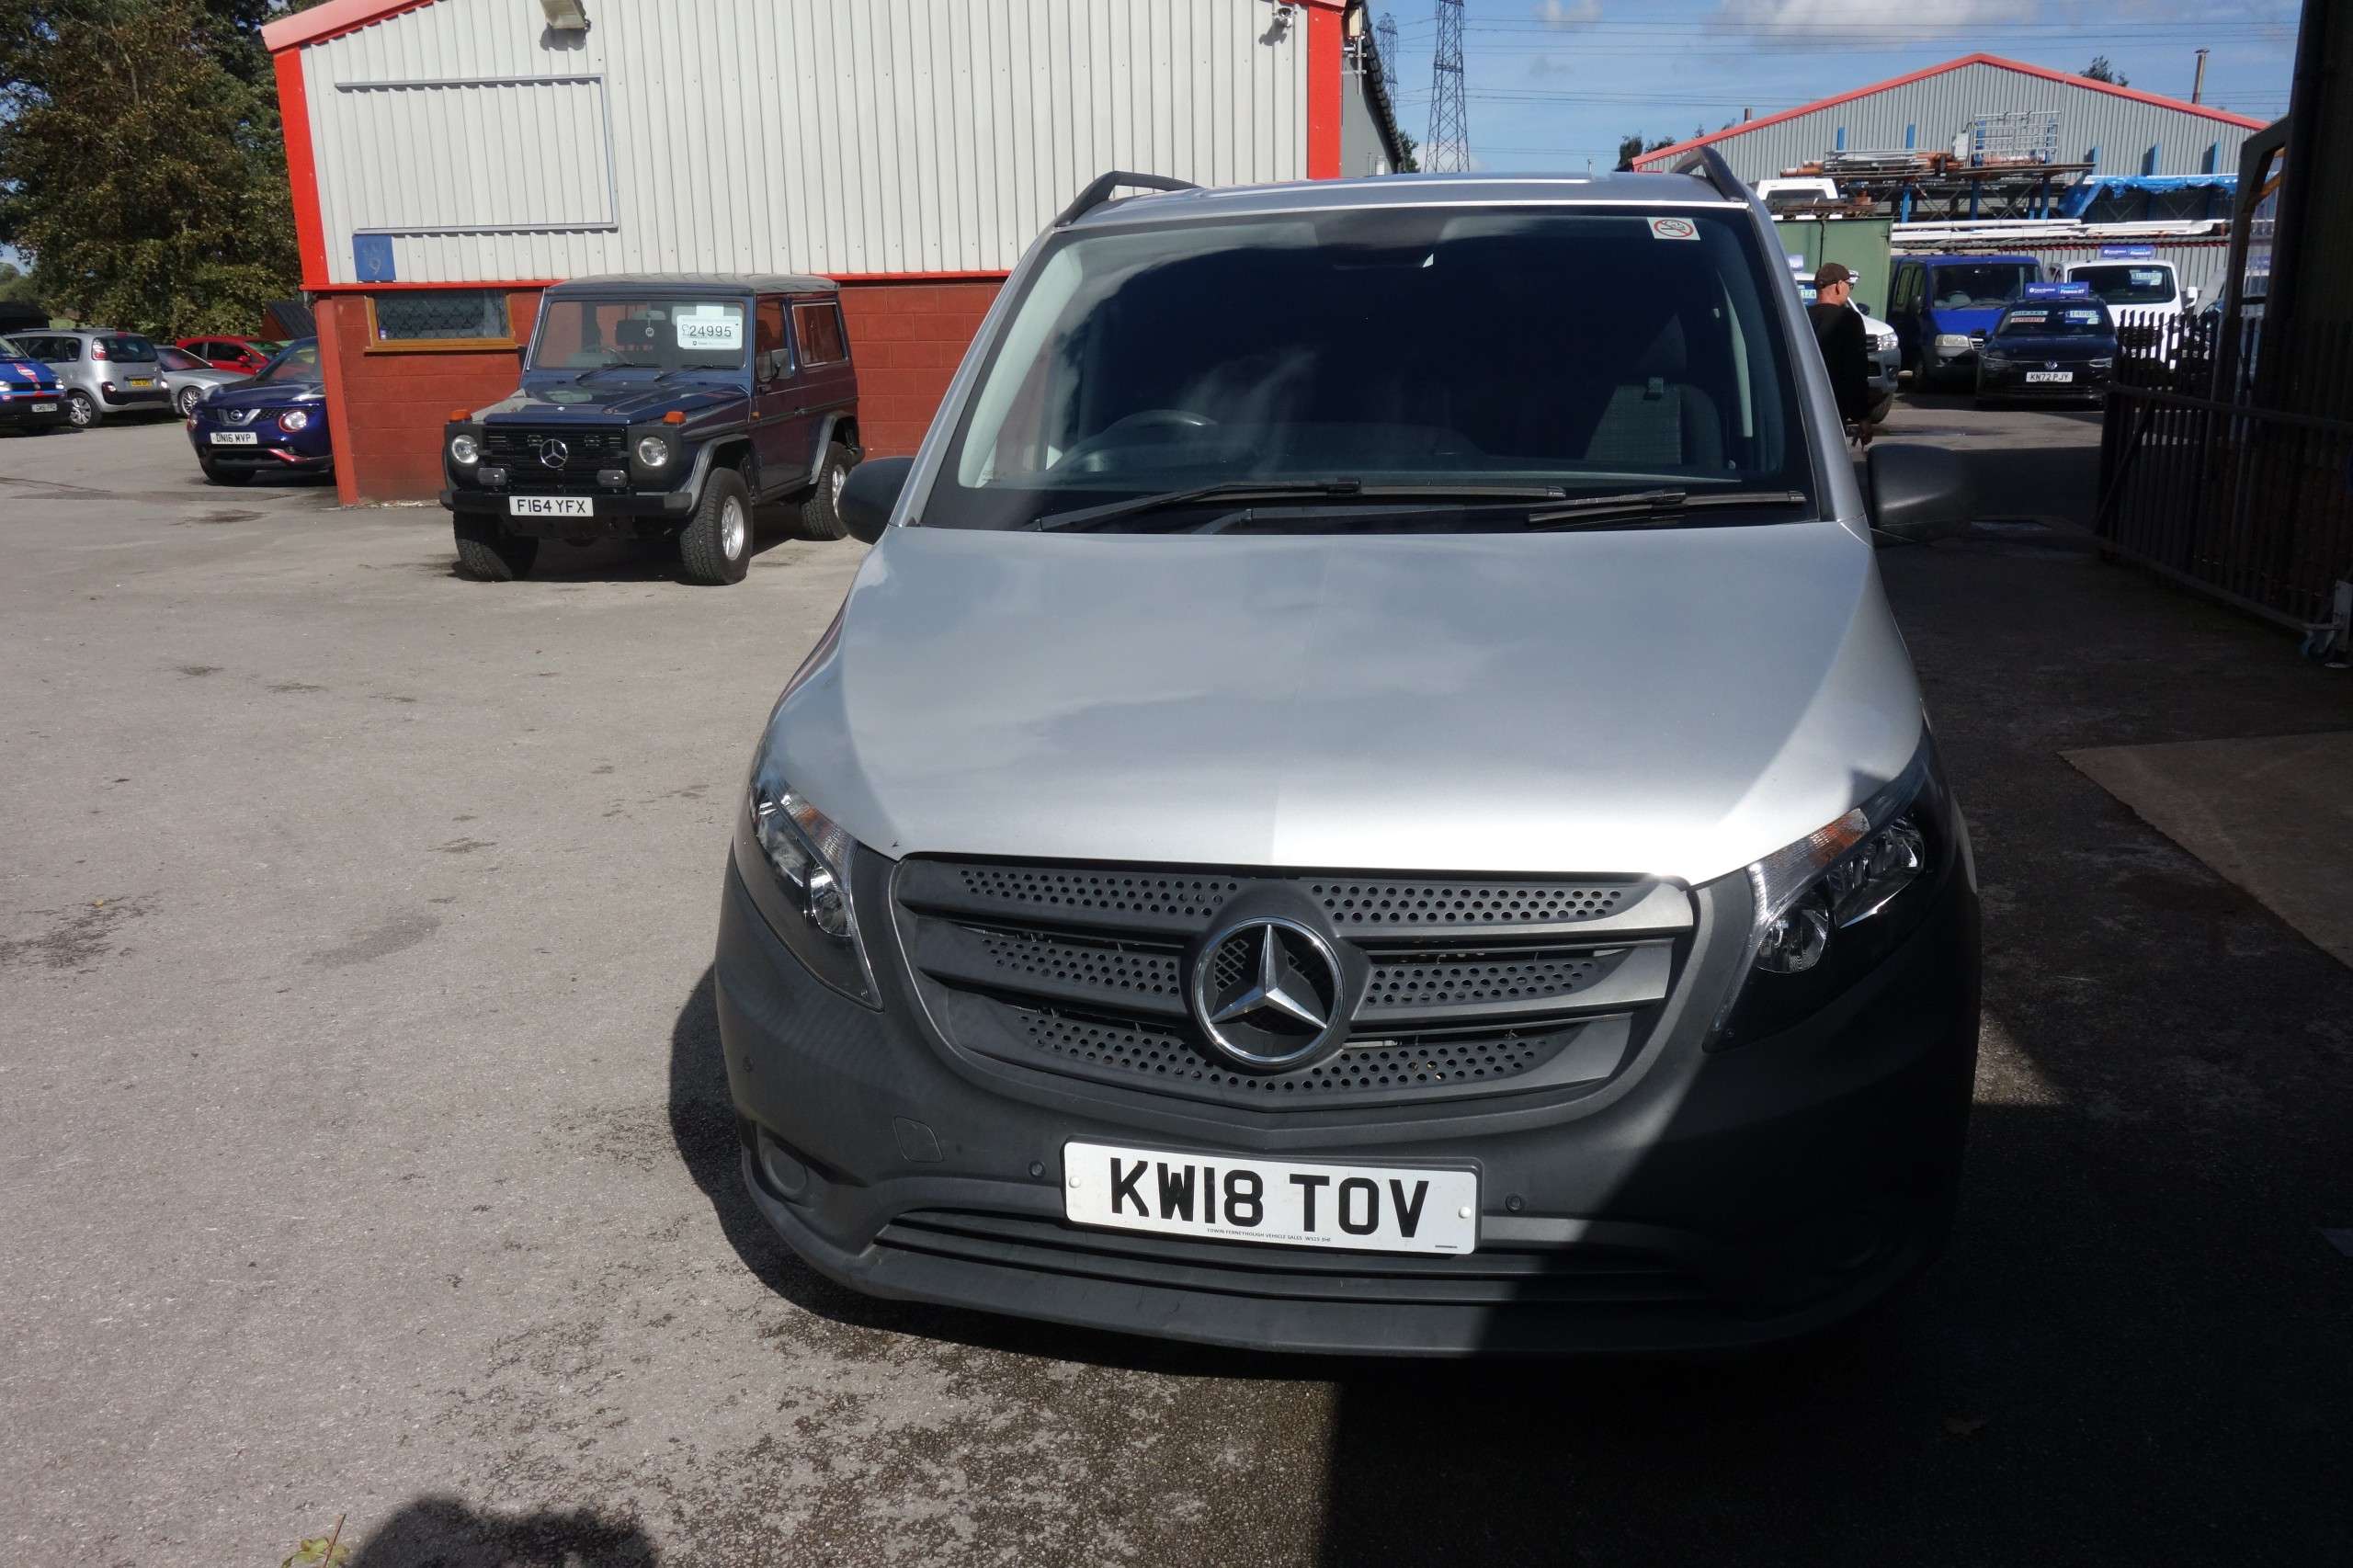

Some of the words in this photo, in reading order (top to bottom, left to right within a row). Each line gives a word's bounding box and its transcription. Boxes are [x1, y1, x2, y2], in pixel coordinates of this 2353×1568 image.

[2029, 373, 2051, 381] KN72
[2053, 373, 2069, 381] PJY
[215, 433, 233, 442] DN16
[234, 433, 251, 442] MVP
[517, 499, 551, 513] F164
[555, 500, 585, 513] YFX
[1109, 1157, 1264, 1228] KW18
[1289, 1173, 1430, 1238] TOV
